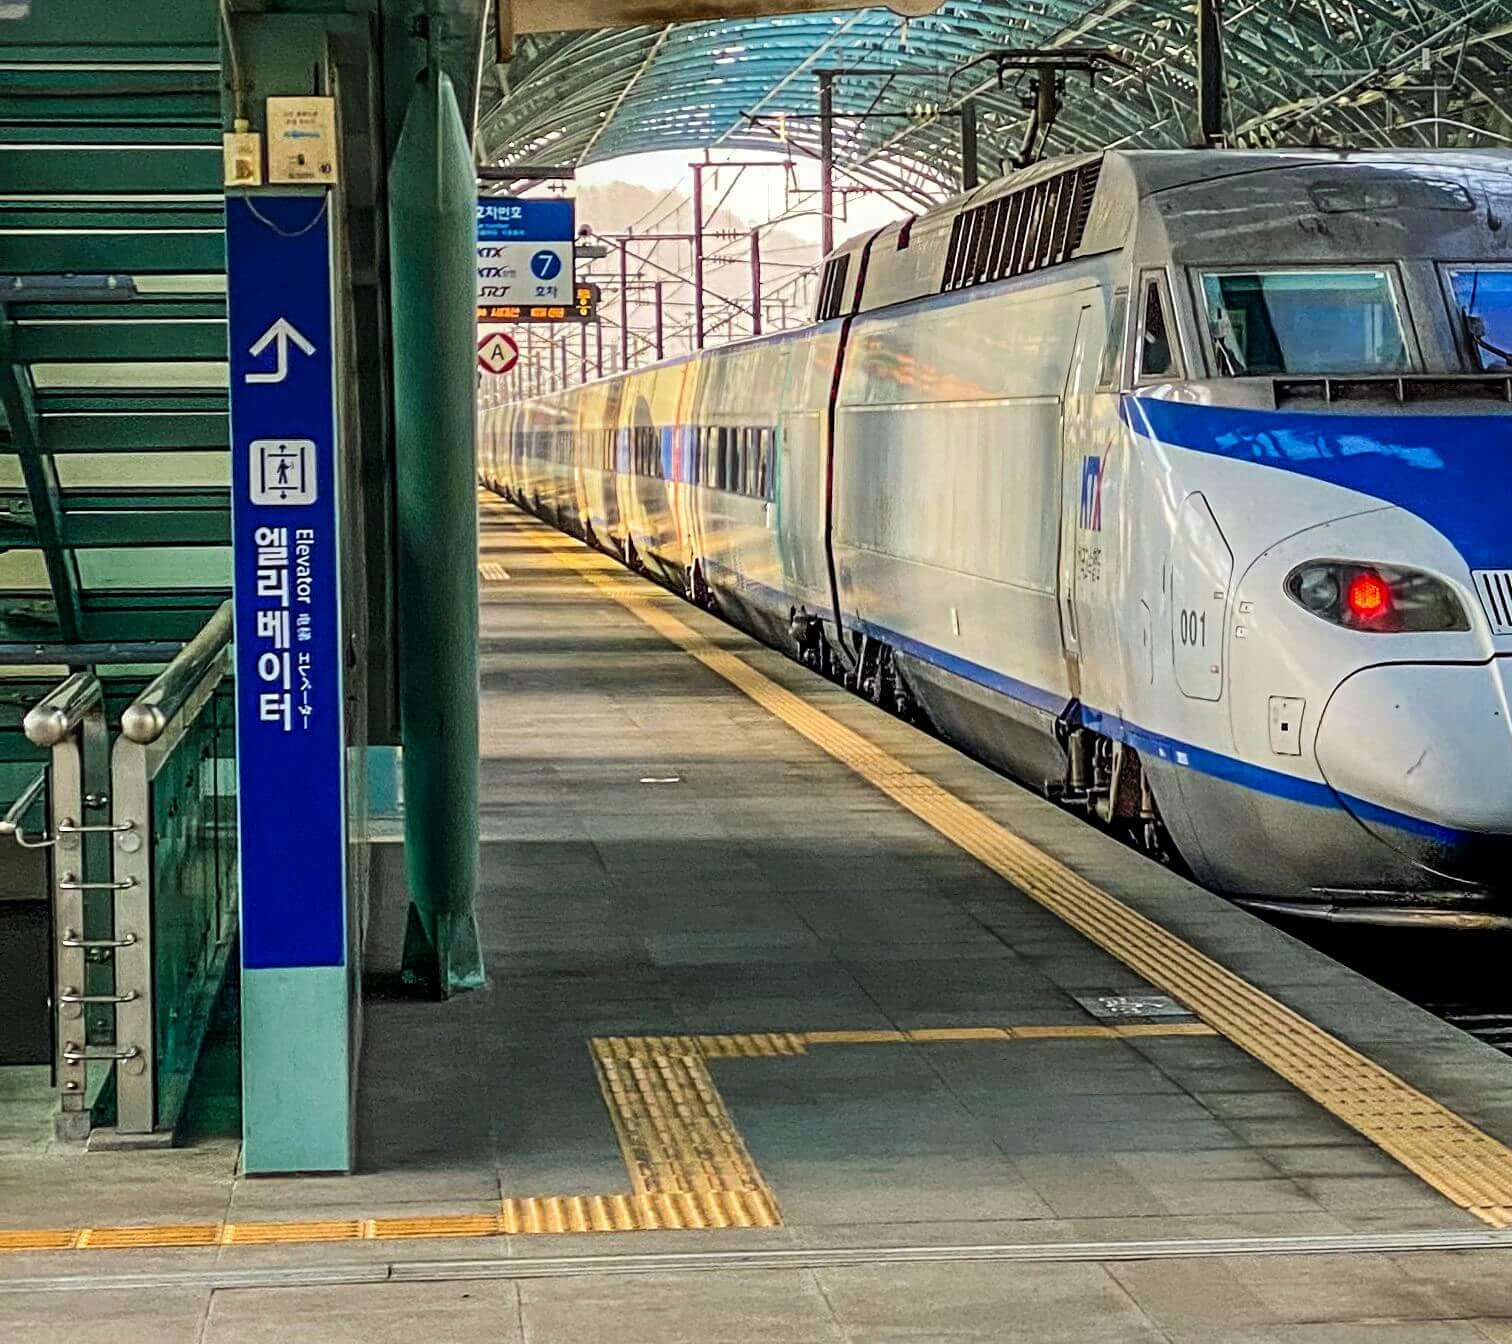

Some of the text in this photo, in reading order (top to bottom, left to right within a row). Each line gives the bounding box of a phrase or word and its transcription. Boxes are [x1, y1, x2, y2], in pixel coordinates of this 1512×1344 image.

[538, 255, 553, 277] 7
[478, 286, 511, 298] SRT
[490, 344, 505, 361] A
[296, 529, 315, 604] Elevator
[254, 526, 292, 732] 엘리베이터
[1180, 609, 1206, 648] 001
[297, 652, 312, 730] エレベーター
